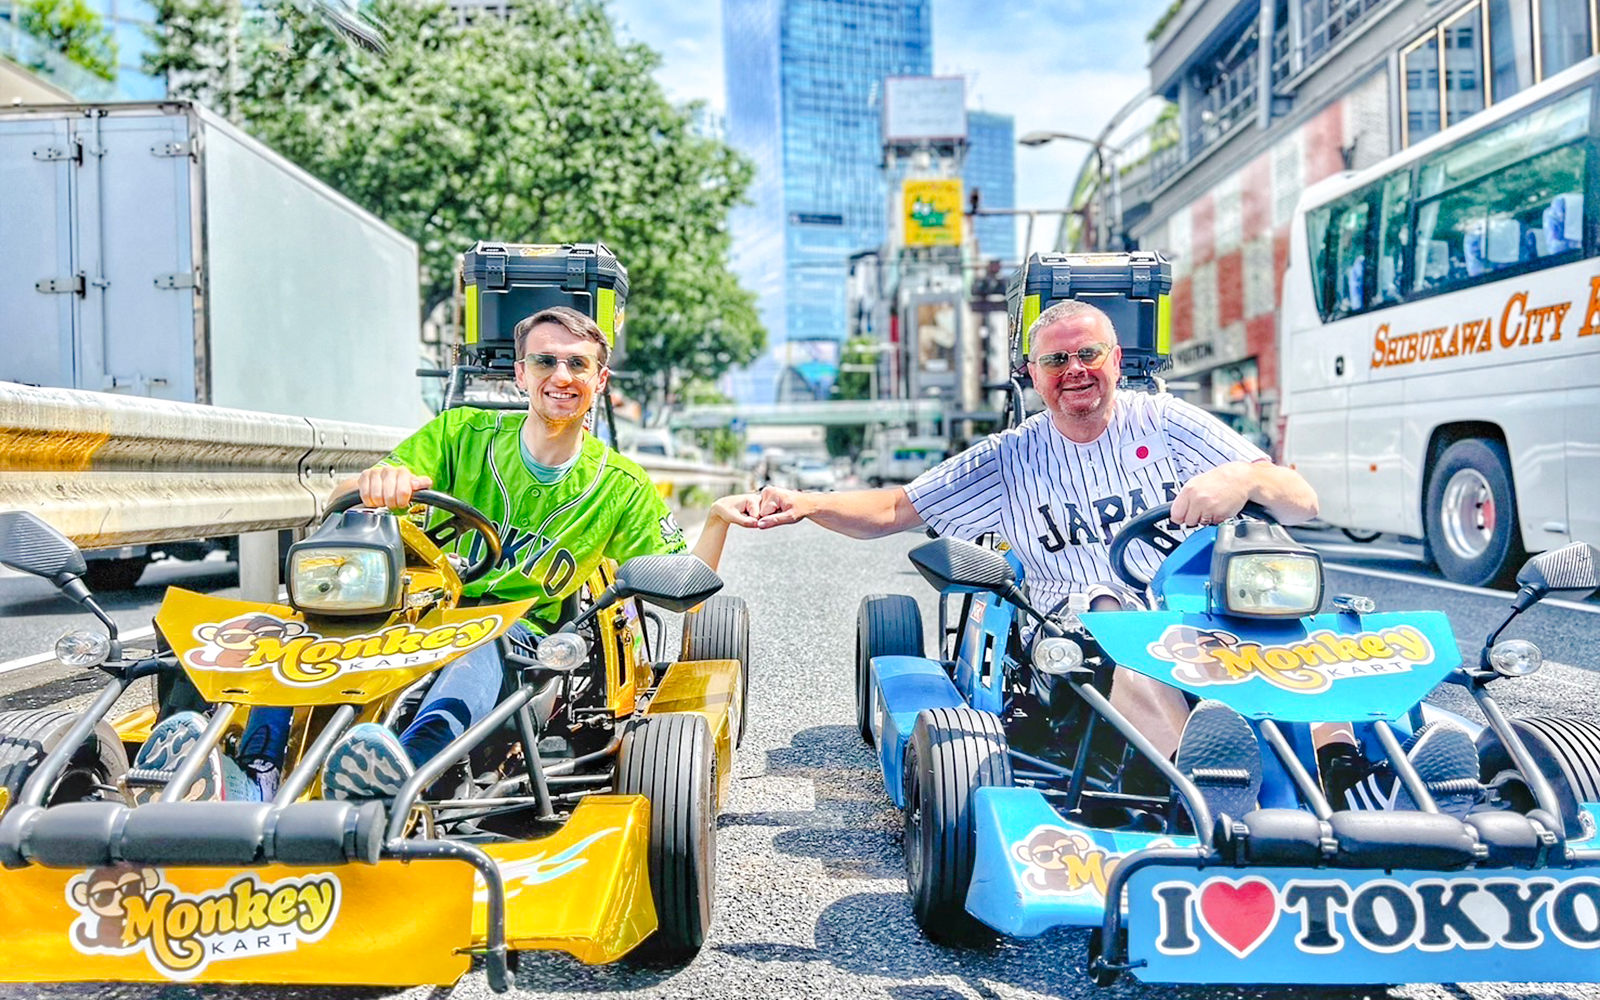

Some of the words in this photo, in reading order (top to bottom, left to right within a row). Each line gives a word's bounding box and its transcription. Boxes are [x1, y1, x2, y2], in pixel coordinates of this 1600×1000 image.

[242, 616, 496, 682] Monkey
[350, 652, 440, 671] KART
[1211, 629, 1430, 689] Monkey
[1329, 661, 1403, 677] KART
[121, 877, 334, 970] Monkey
[211, 931, 292, 955] KART
[1286, 881, 1600, 947] TOKYO
